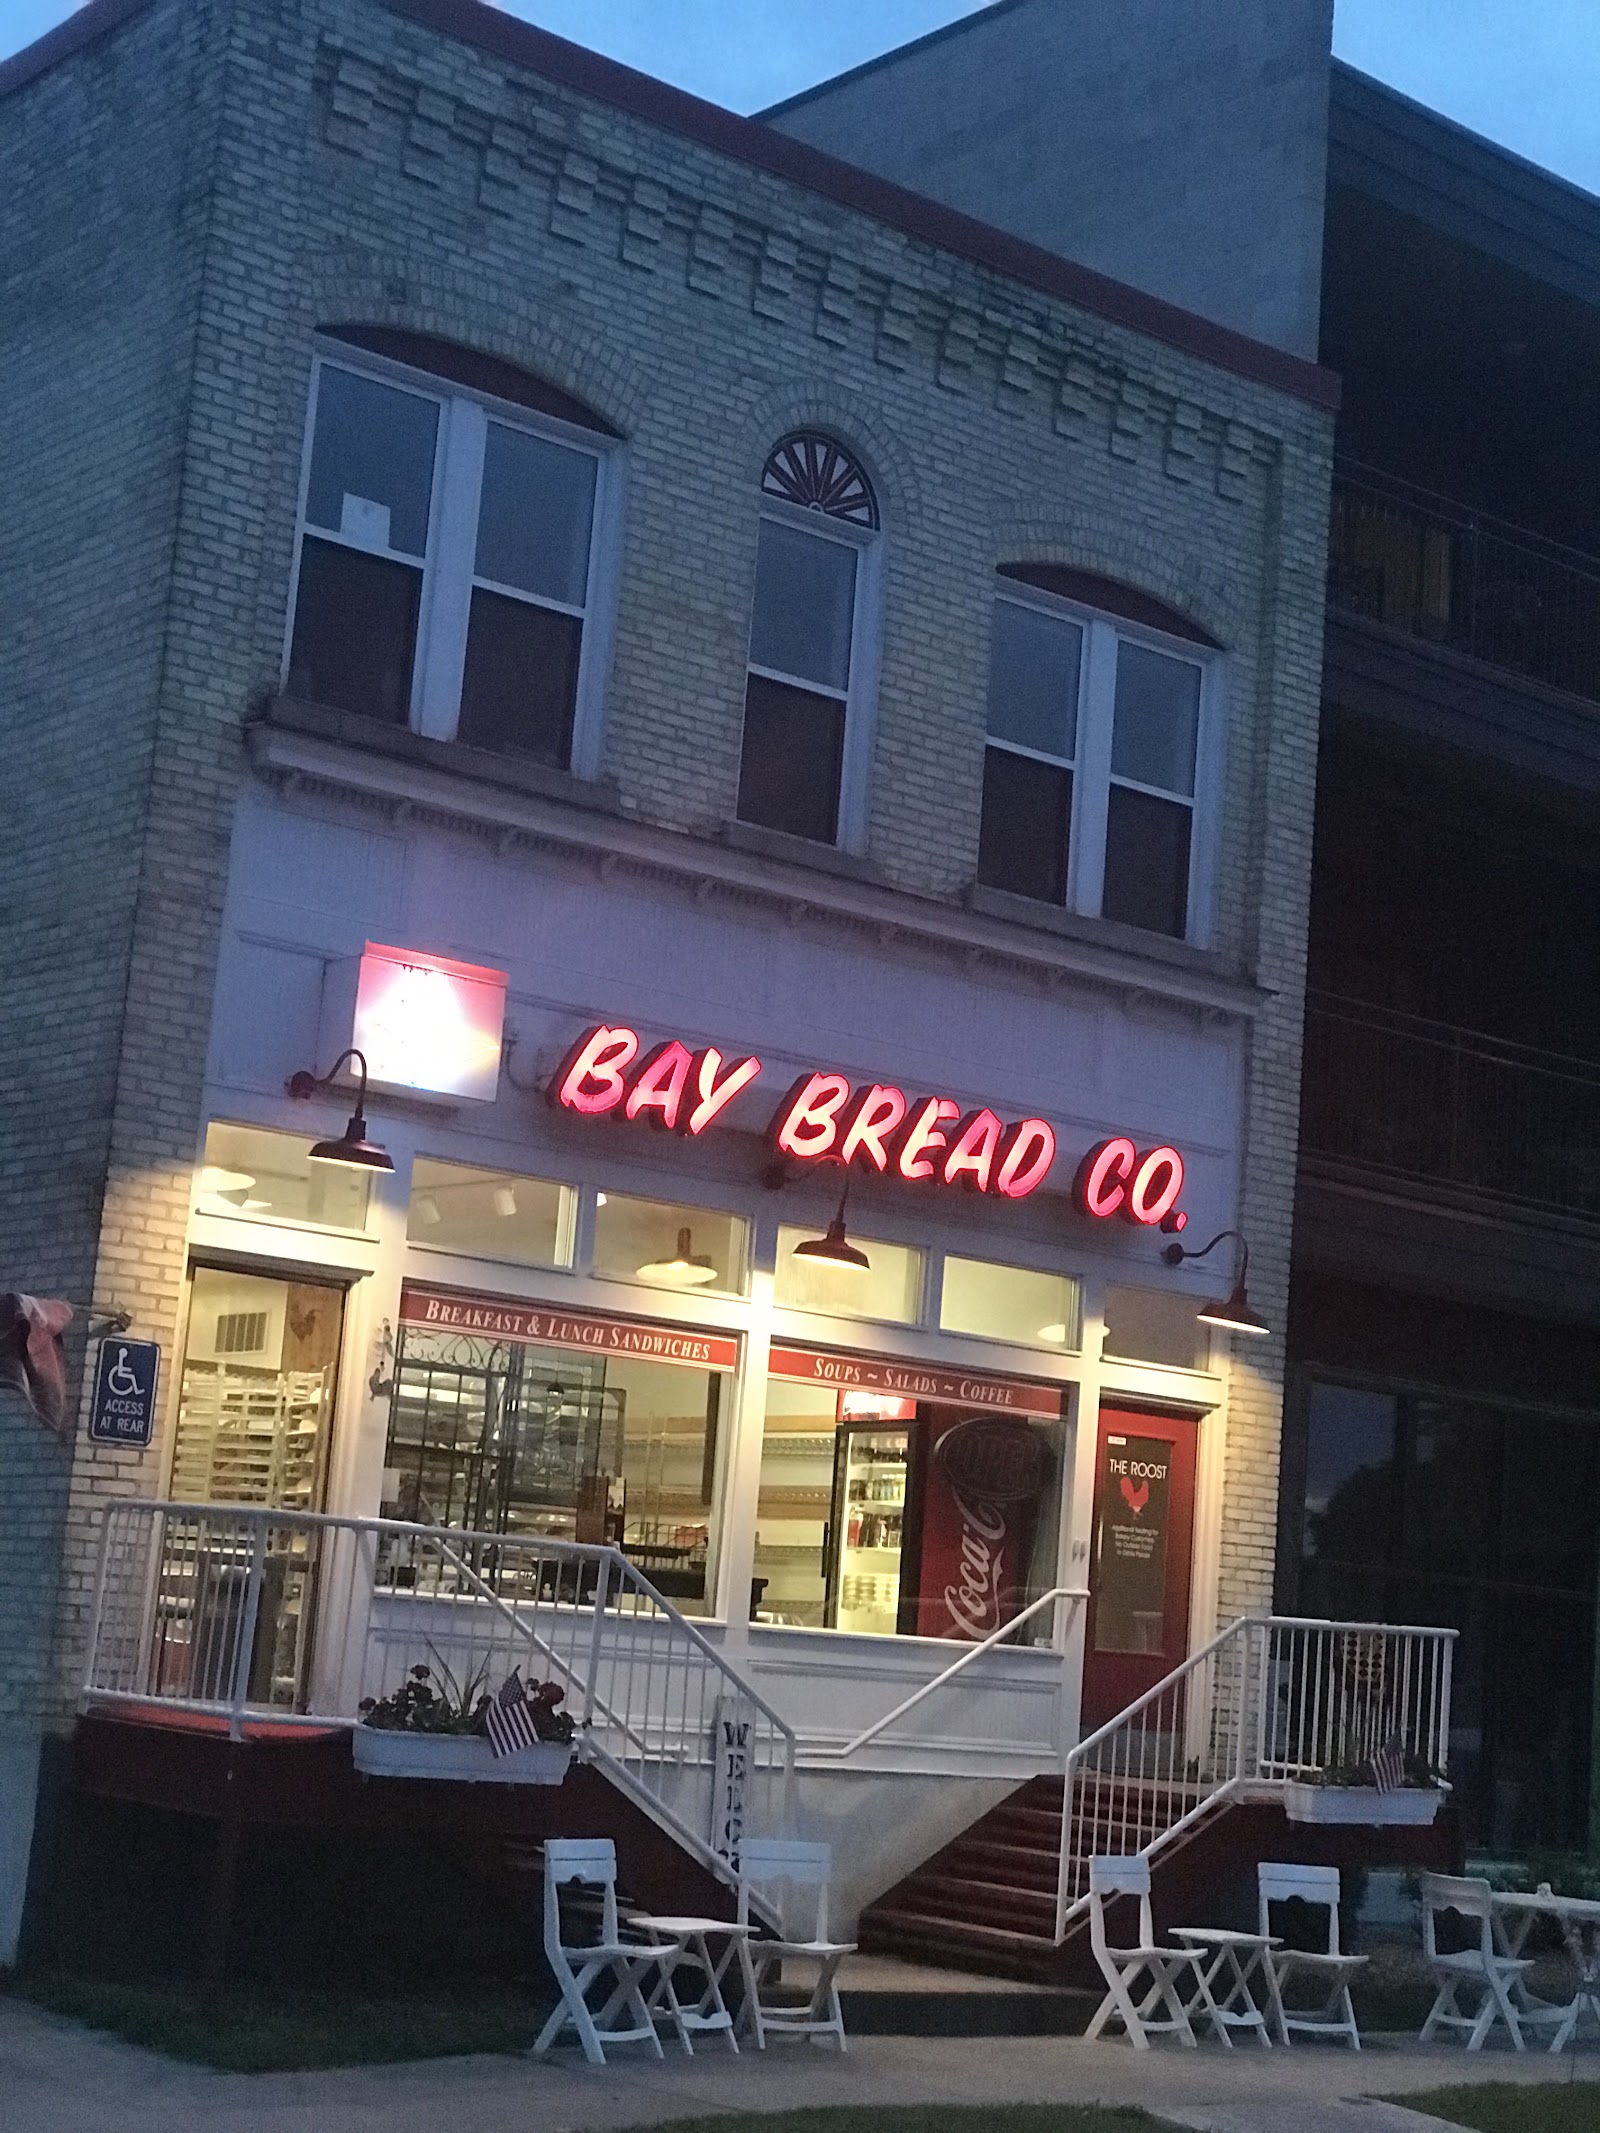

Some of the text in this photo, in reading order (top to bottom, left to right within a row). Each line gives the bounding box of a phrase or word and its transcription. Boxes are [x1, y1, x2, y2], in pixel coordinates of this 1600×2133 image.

[560, 1024, 1188, 1232] BAY BREAD CO.
[526, 1315, 541, 1335] &
[547, 1317, 604, 1344] LUNCH
[609, 1326, 711, 1360] SANDWICHES
[104, 1399, 145, 1416] ACCESS
[100, 1416, 145, 1433] AT REAR
[1109, 1458, 1168, 1480] THE ROOST
